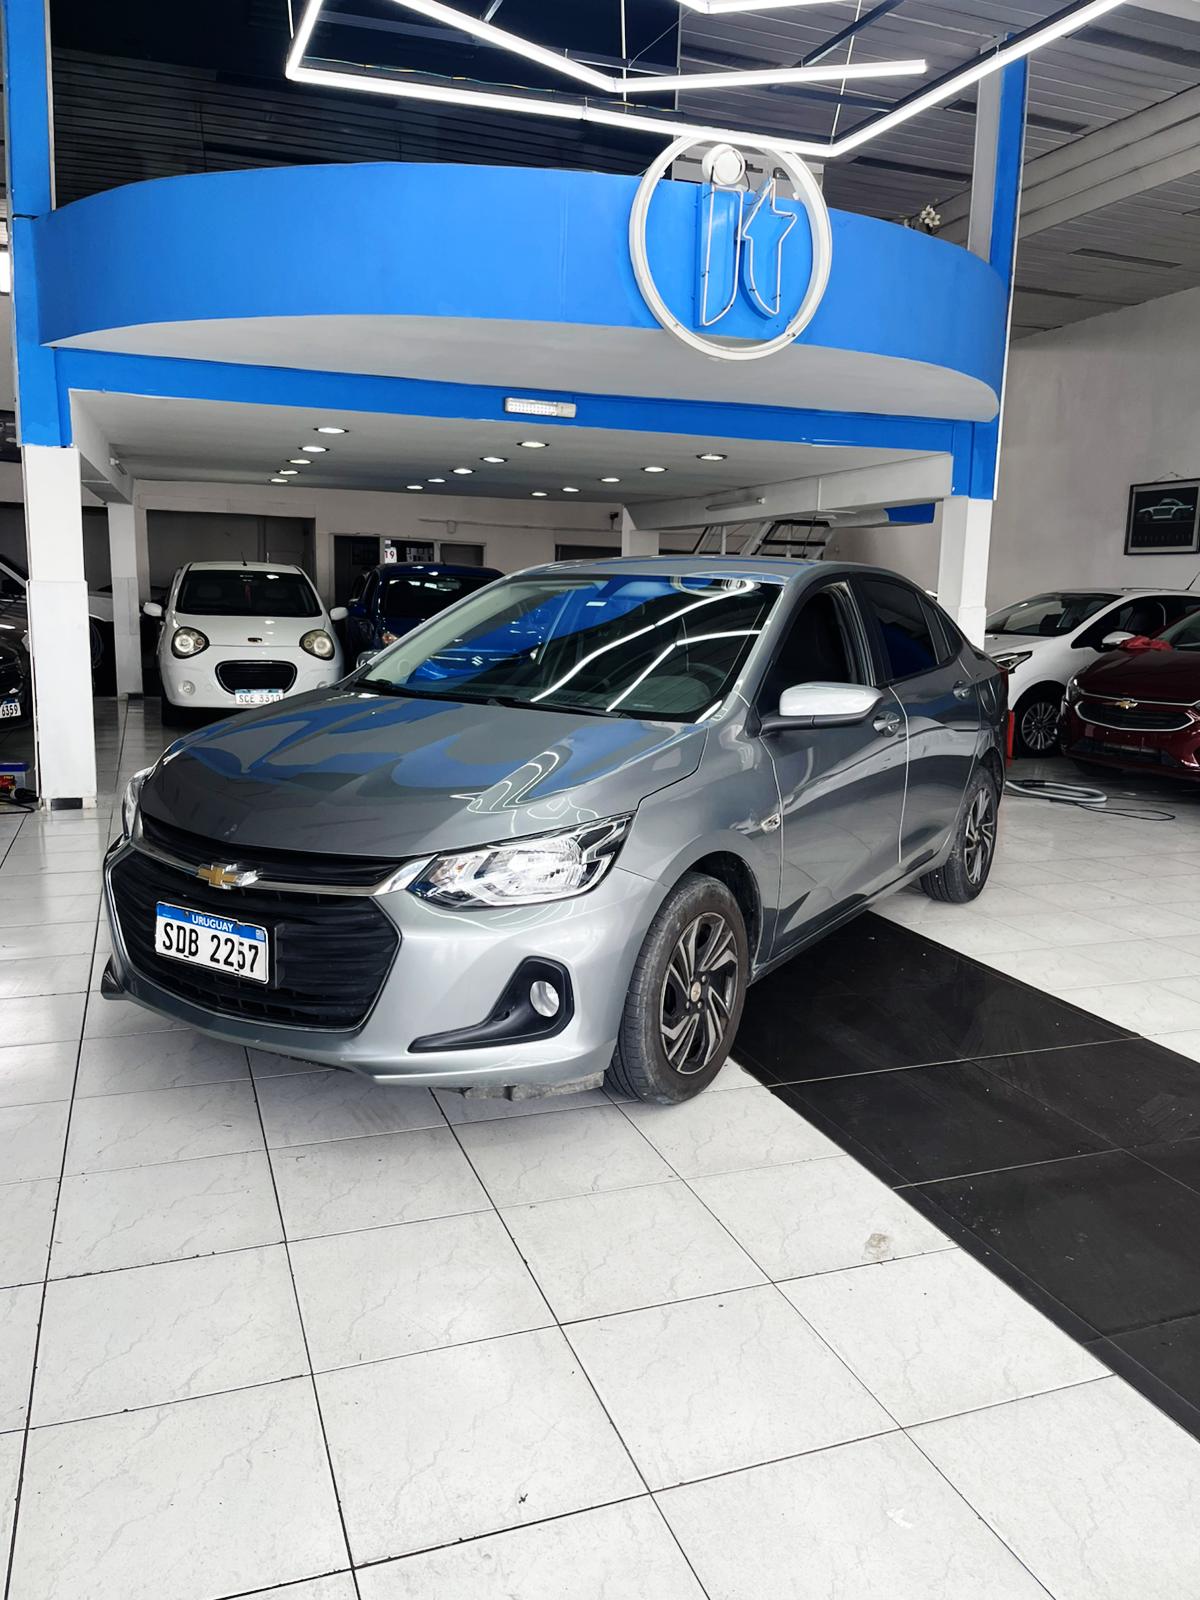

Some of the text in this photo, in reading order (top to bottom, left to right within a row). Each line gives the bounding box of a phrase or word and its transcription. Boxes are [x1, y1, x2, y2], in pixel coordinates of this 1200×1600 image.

[2, 704, 18, 717] 6359
[192, 914, 234, 932] URUGUAY
[162, 922, 259, 973] SDB 2257
